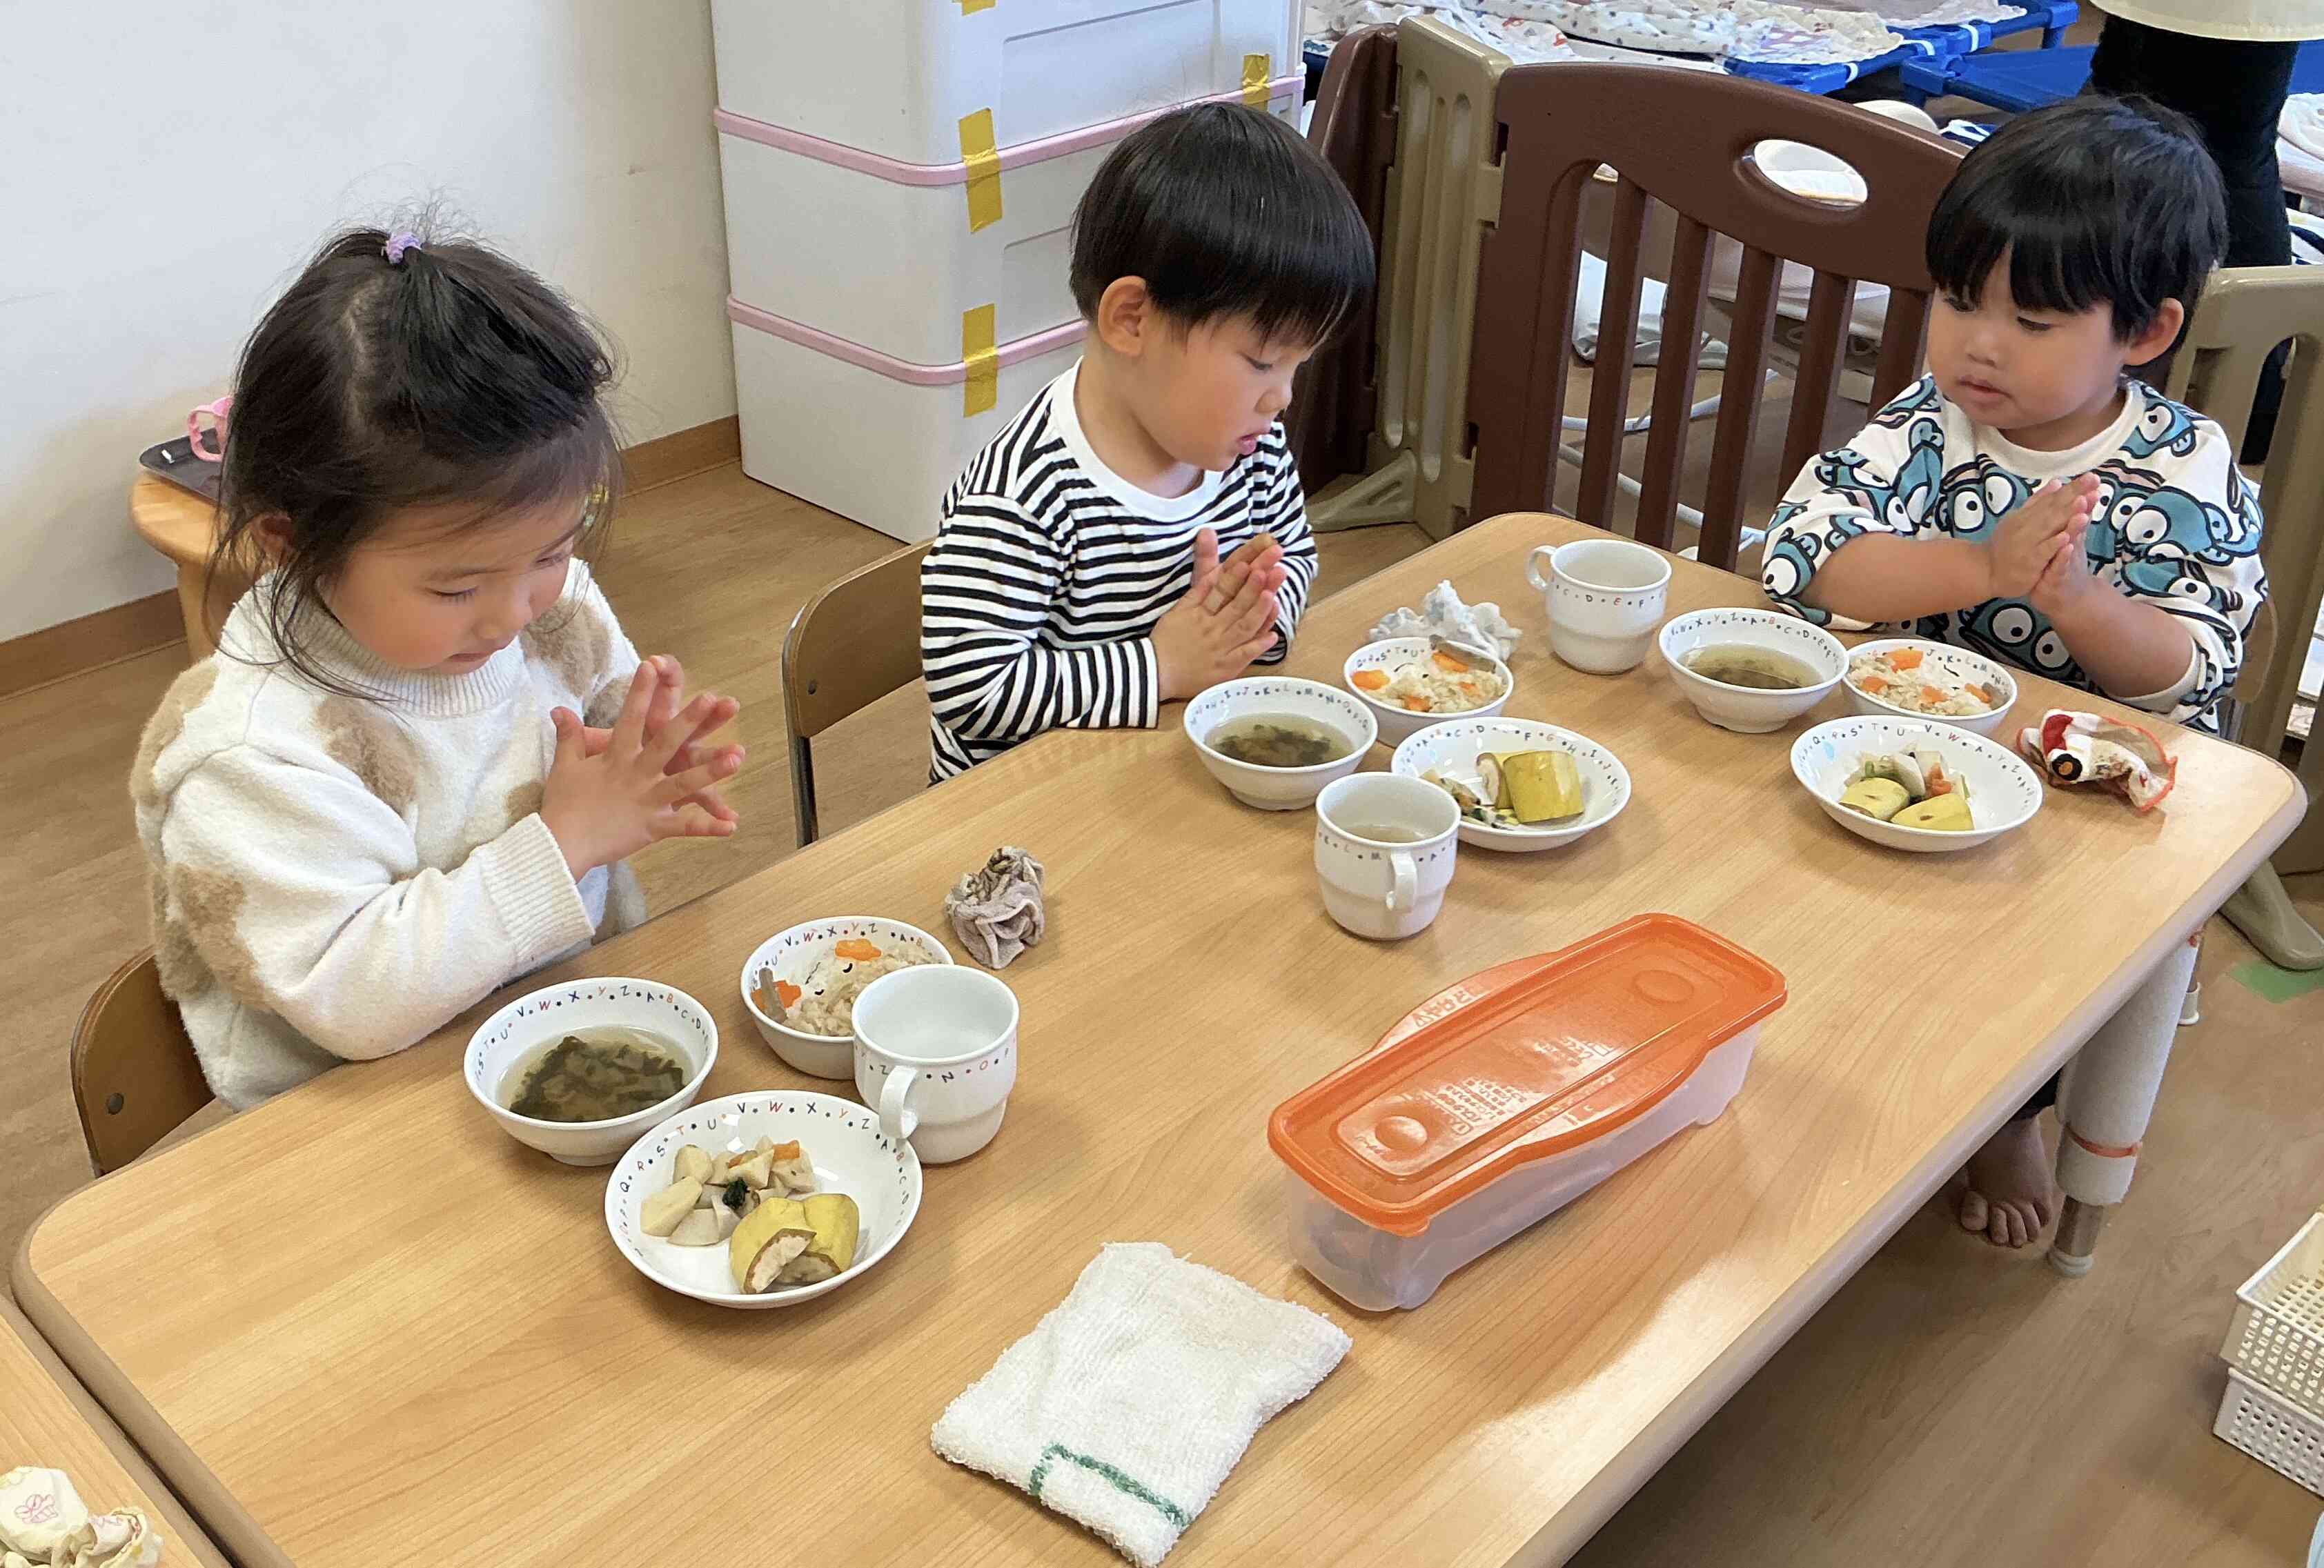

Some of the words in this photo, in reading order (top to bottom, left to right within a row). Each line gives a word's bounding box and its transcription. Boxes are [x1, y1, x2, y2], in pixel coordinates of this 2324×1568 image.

[1925, 724, 1932, 733] V
[1949, 733, 1959, 741] W
[1568, 745, 1576, 753] H
[804, 933, 814, 942] W
[828, 926, 837, 937] X
[851, 923, 859, 931] Y
[869, 923, 878, 933] Z
[501, 1030, 508, 1040] U
[517, 1007, 524, 1017] V
[540, 1001, 551, 1011] W
[569, 991, 580, 1002] X
[598, 986, 606, 995] Y
[621, 985, 630, 995] Z
[647, 992, 654, 1001] A
[979, 1060, 988, 1070] O
[620, 1182, 630, 1192] Q
[638, 1161, 645, 1170] R
[657, 1145, 665, 1157] S
[676, 1125, 685, 1135] T
[708, 1119, 716, 1129] U
[738, 1102, 745, 1113] V
[769, 1101, 783, 1112] W
[807, 1102, 817, 1113] X
[839, 1109, 849, 1118] Y
[862, 1118, 870, 1129] Z
[899, 1176, 906, 1184] C
